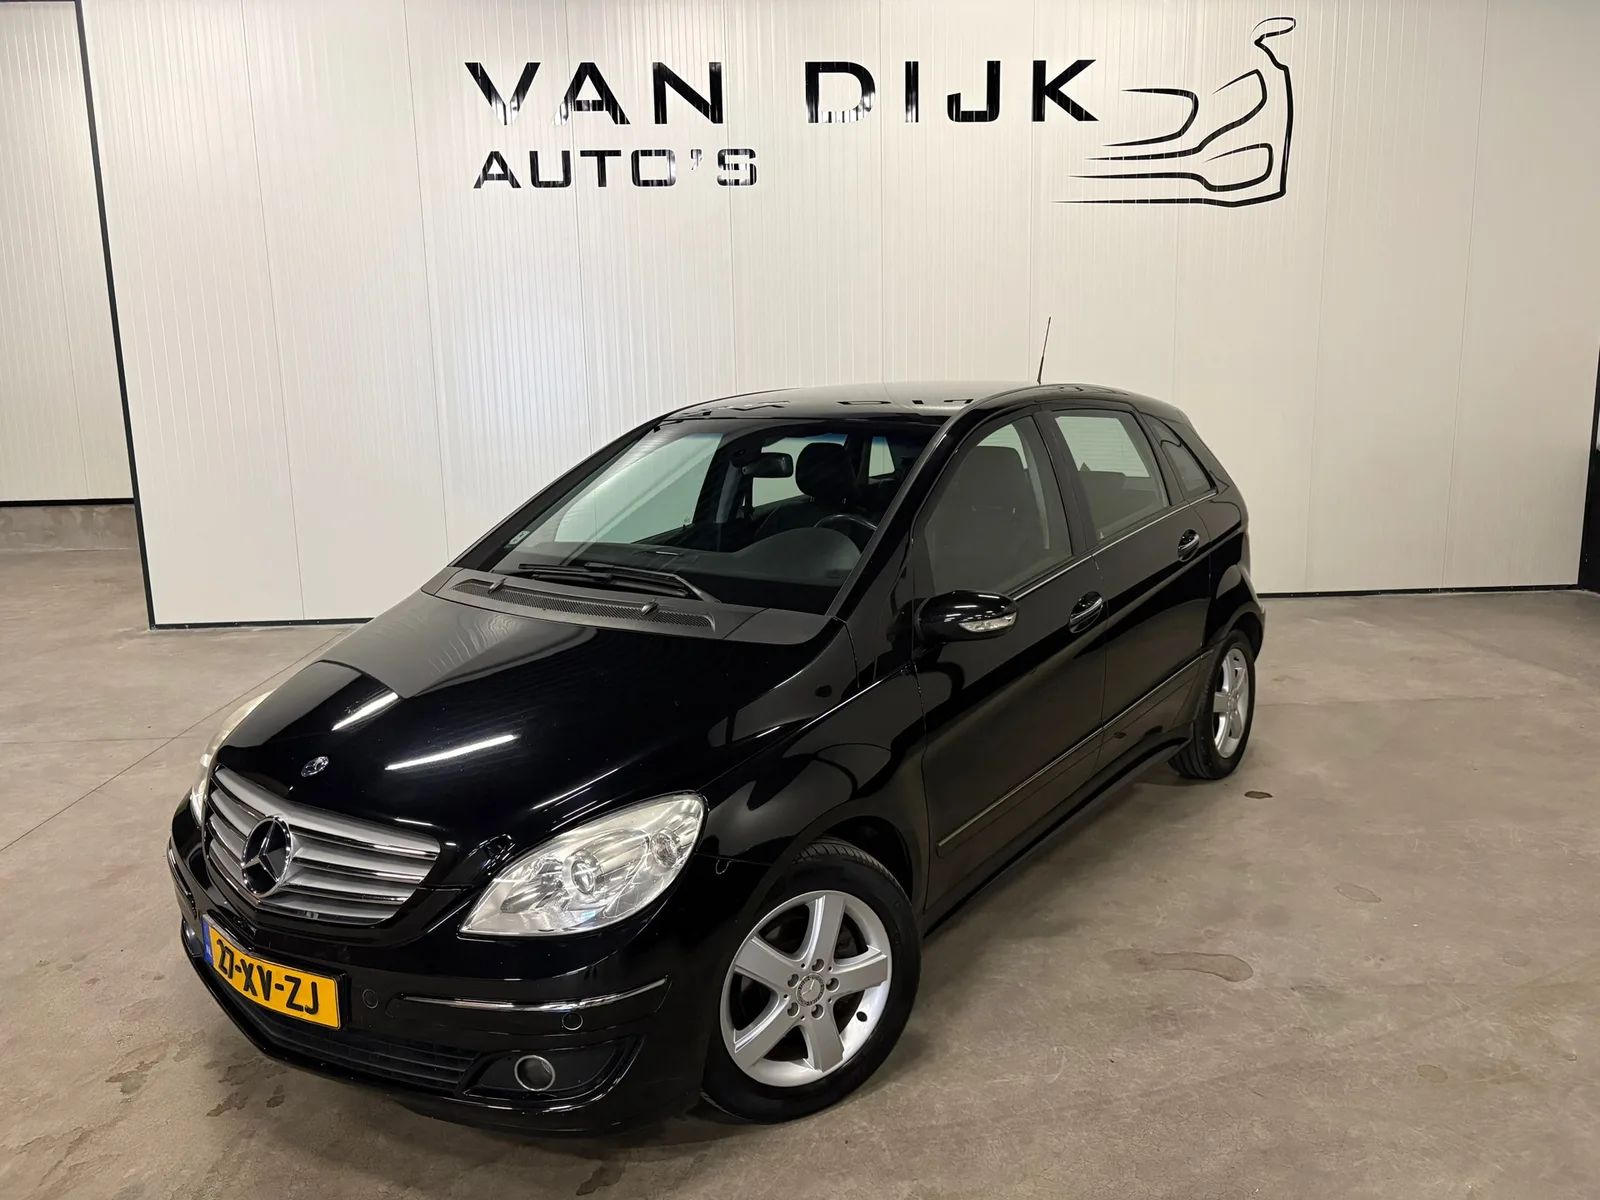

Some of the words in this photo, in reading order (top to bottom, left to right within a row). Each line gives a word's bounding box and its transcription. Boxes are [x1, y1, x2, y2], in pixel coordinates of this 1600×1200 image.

[464, 61, 723, 125] VAN
[805, 59, 1099, 123] DIJK
[473, 148, 757, 188] AUTO'S
[217, 939, 319, 1014] 27-XV-ZJ
